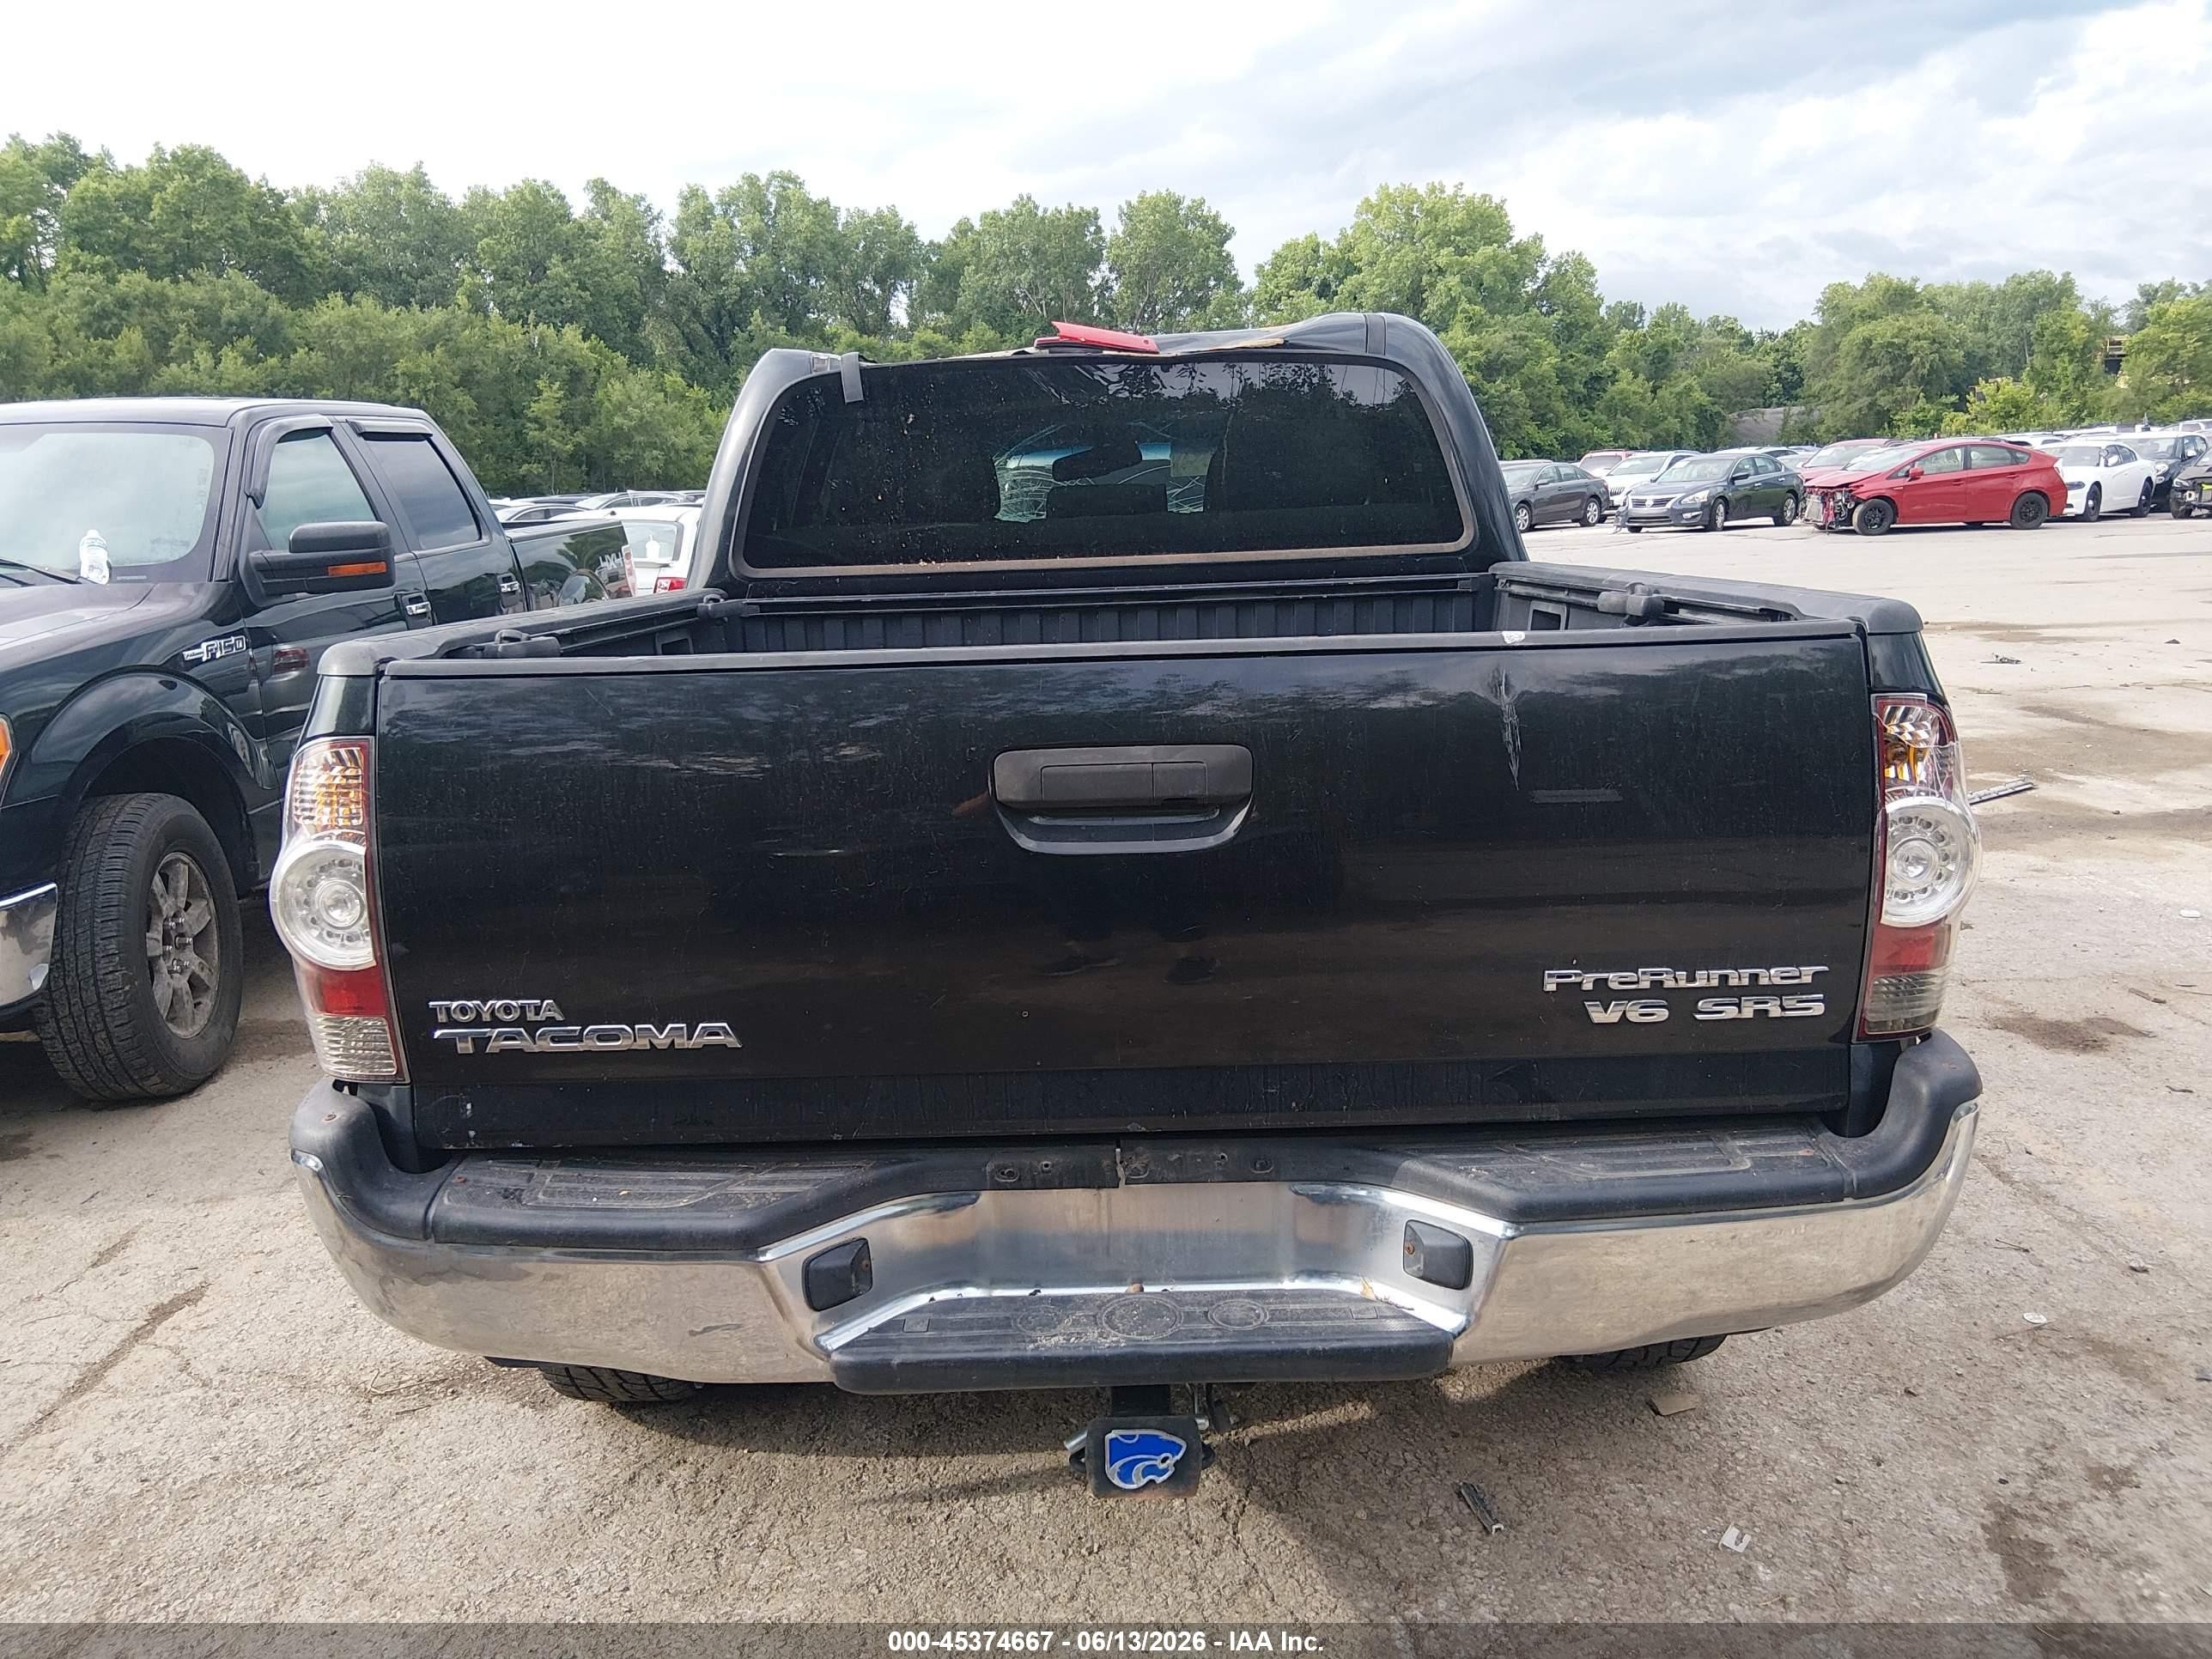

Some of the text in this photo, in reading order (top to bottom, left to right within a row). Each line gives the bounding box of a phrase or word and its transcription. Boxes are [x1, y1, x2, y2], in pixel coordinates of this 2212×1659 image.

[1542, 965, 1830, 992] PreRunner
[428, 999, 565, 1024] TOYOTA
[1583, 993, 1826, 1024] V6 SR5
[434, 1022, 743, 1054] TACOMA
